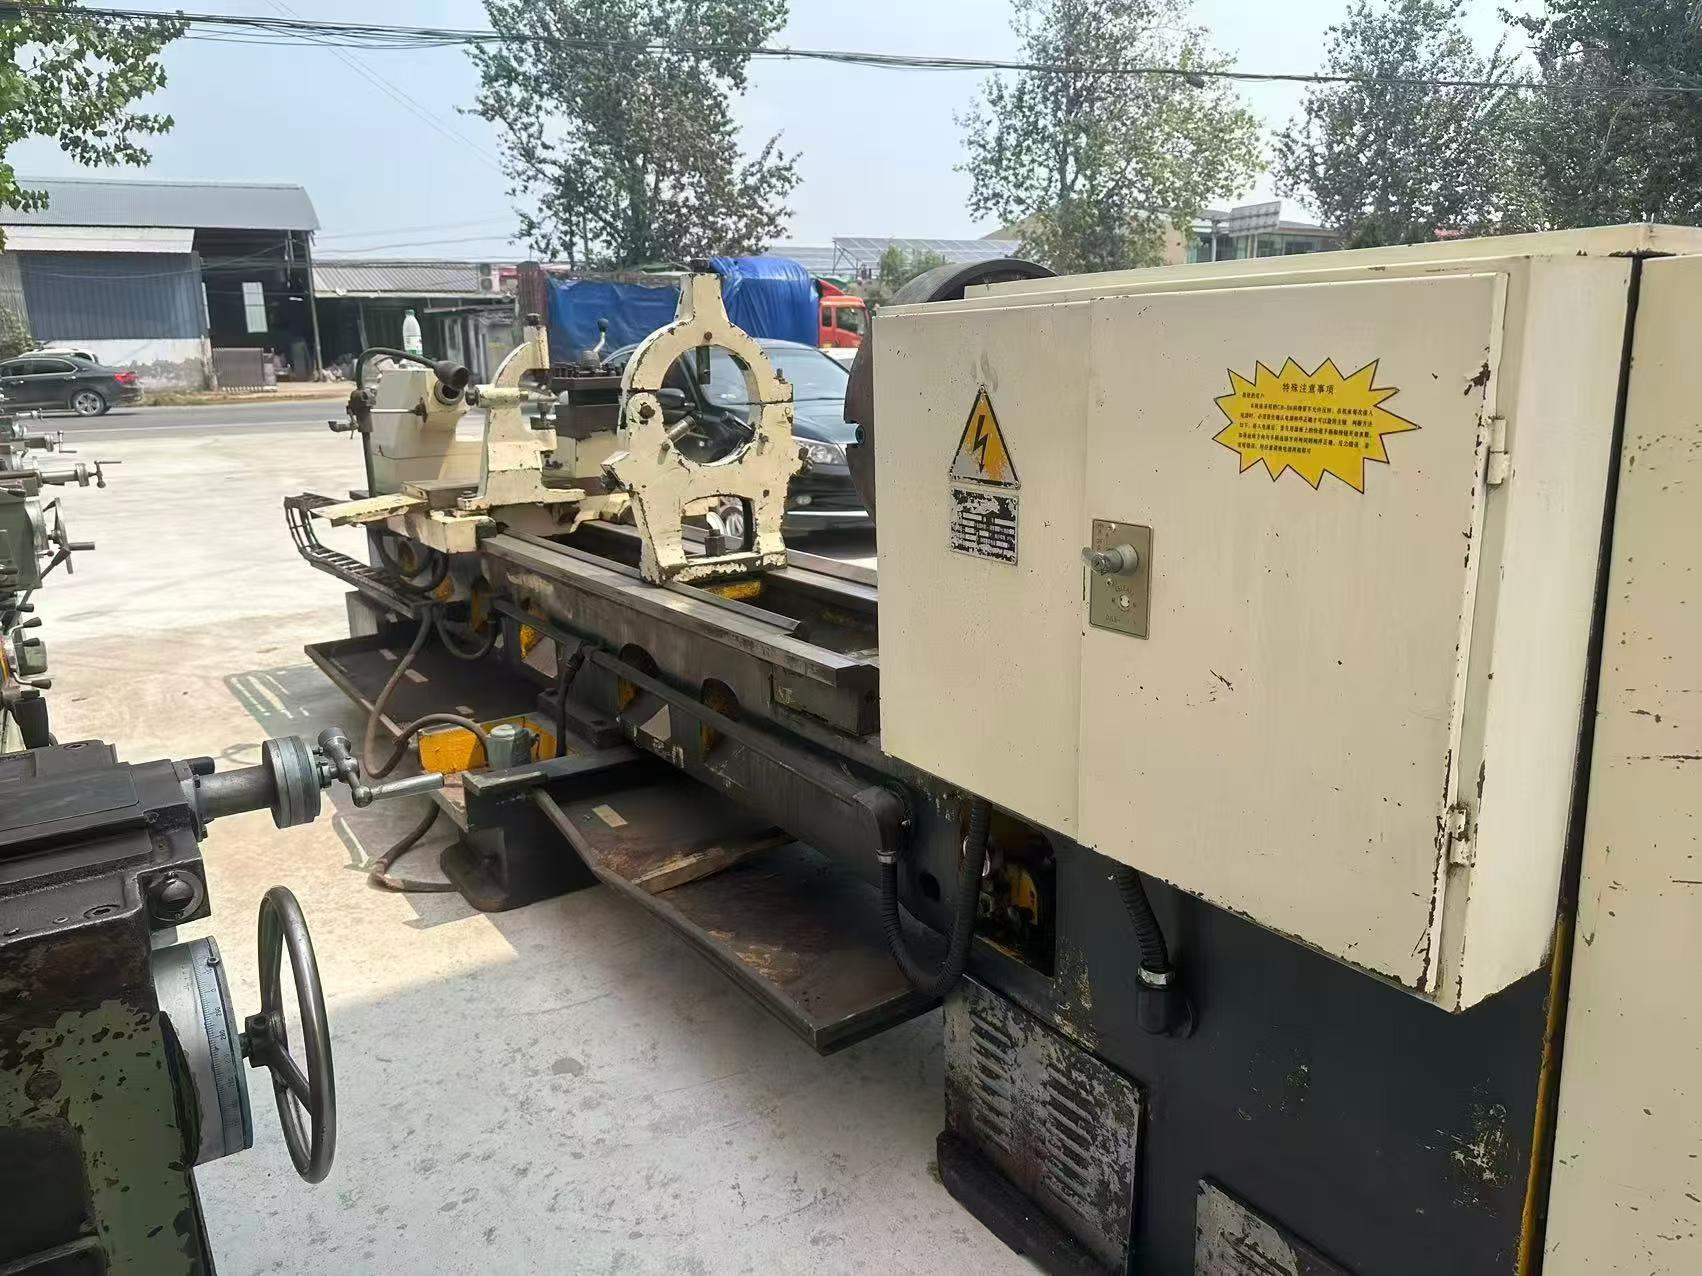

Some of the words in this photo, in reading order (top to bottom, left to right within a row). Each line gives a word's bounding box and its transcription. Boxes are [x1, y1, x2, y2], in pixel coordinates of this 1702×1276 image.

[1282, 383, 1334, 394] 特殊注意事项
